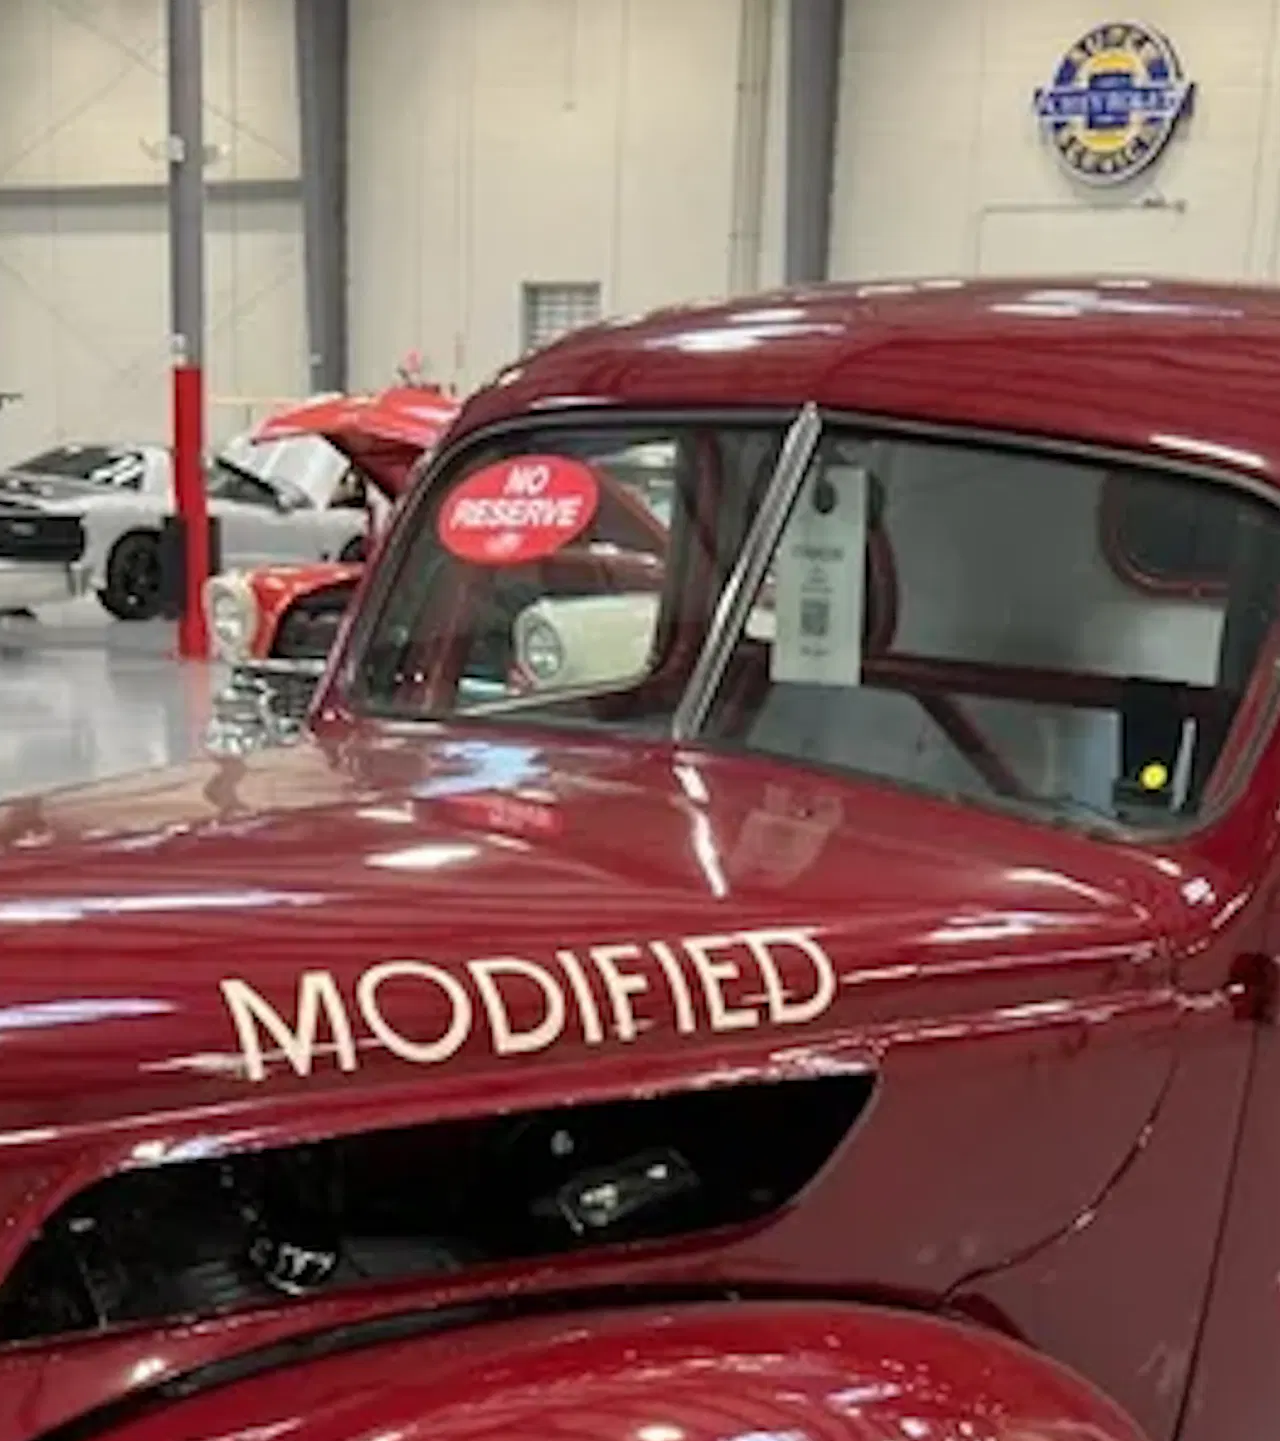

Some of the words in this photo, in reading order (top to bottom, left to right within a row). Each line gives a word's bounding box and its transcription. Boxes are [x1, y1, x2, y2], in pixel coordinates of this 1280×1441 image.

[502, 464, 551, 497] NO
[449, 493, 584, 530] RESERVE
[219, 924, 838, 1082] MODIFIED
